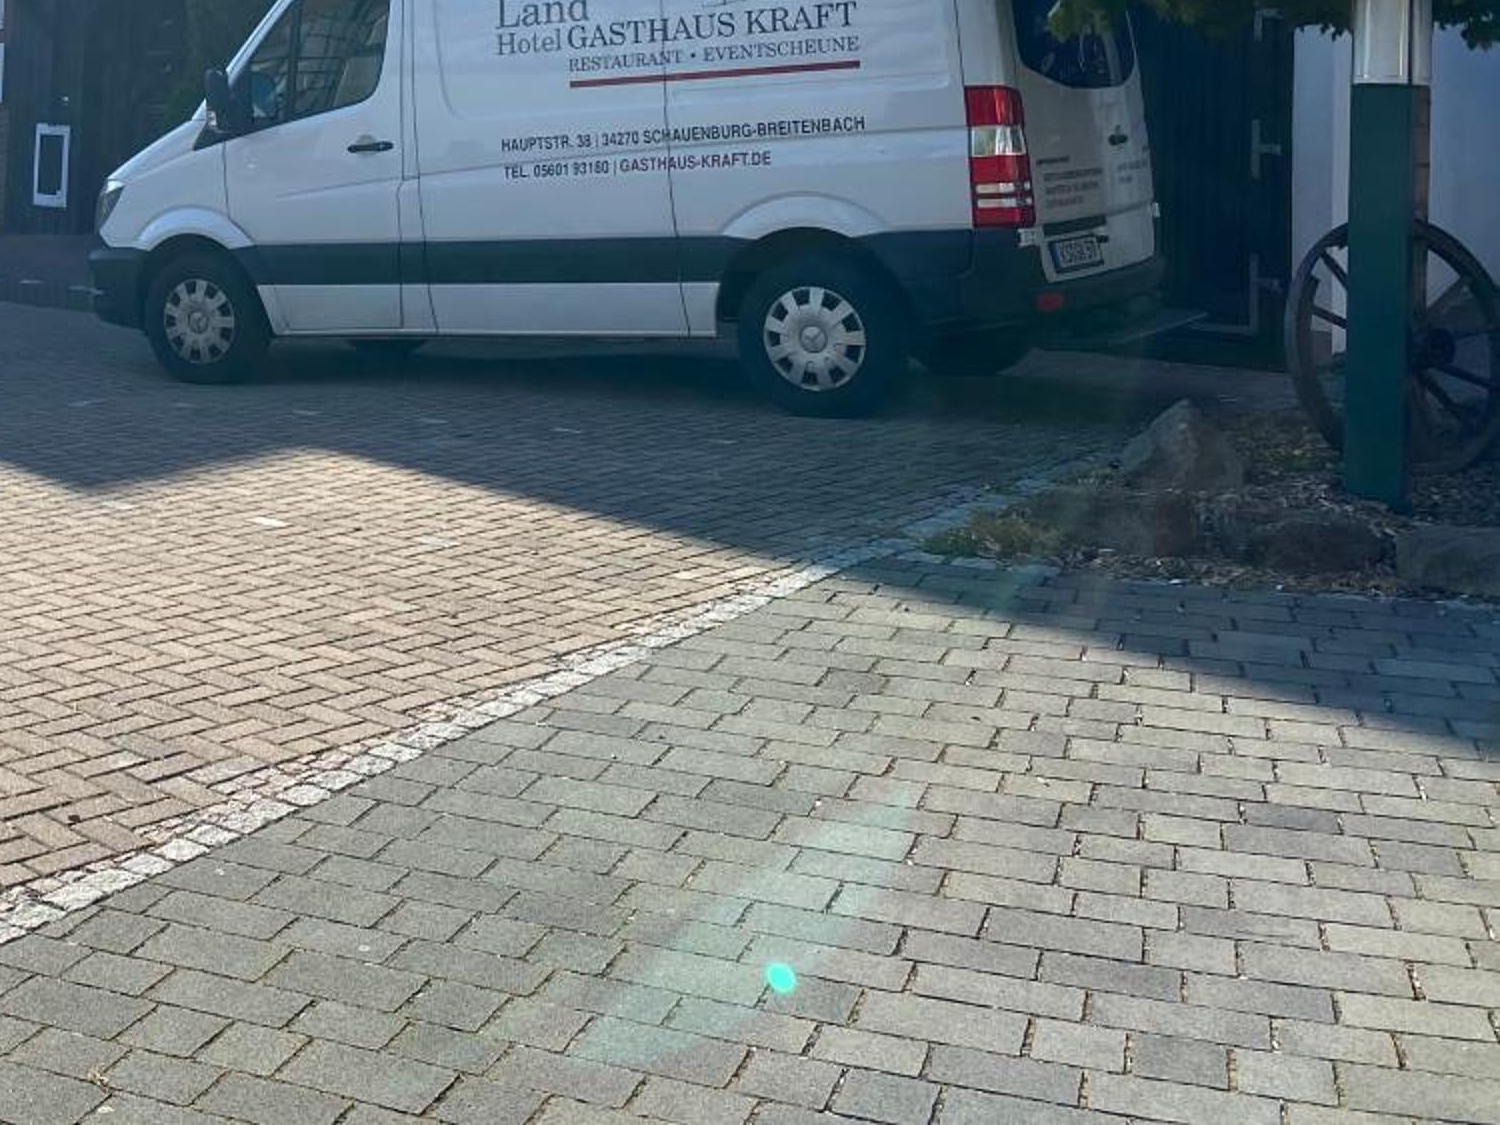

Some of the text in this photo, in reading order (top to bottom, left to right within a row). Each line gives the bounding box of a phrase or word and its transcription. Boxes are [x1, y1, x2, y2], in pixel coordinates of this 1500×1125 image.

[497, 0, 857, 56] Hotel GASTHAUS KRAFT
[569, 36, 860, 72] RESTAURANT EVENTSCHEUNE
[501, 134, 575, 152] HAUPTSTR.
[602, 130, 640, 146] 34270
[643, 115, 866, 145] SCHAUENBURG-BREITENBACH
[504, 165, 530, 179] TEL.
[533, 161, 570, 178] 05601
[619, 150, 772, 173] GASTHAUS-KRAFT.DE
